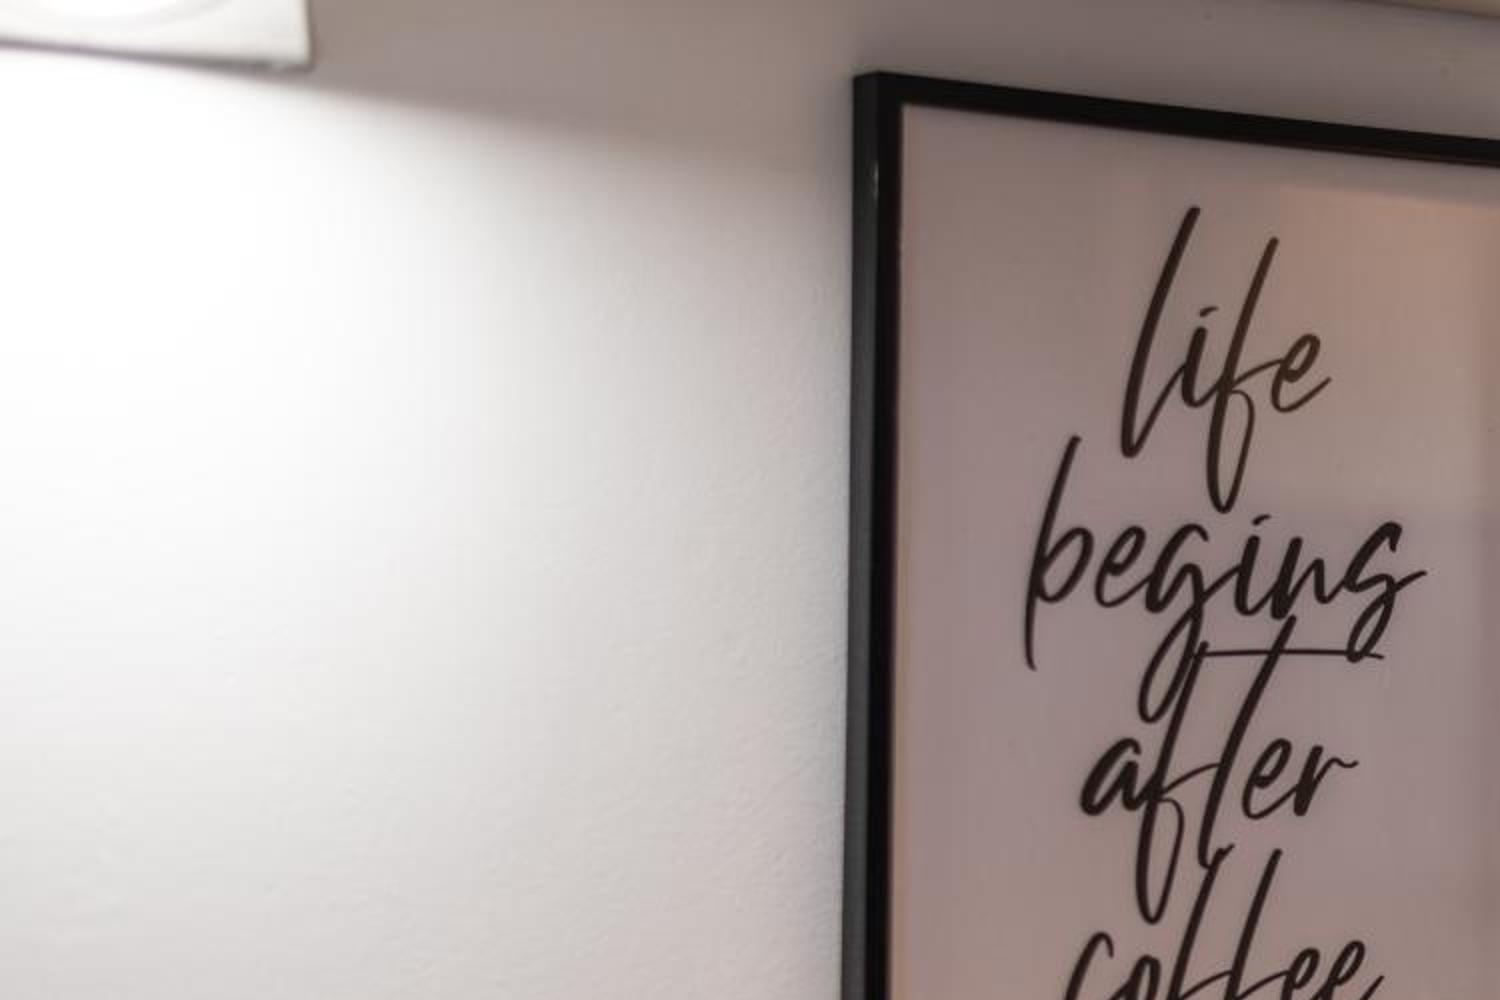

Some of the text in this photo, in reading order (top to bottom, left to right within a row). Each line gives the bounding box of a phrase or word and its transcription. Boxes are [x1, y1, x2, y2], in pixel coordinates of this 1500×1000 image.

[1120, 206, 1331, 514] life
[1024, 435, 1427, 722] begins
[1079, 616, 1384, 923] after
